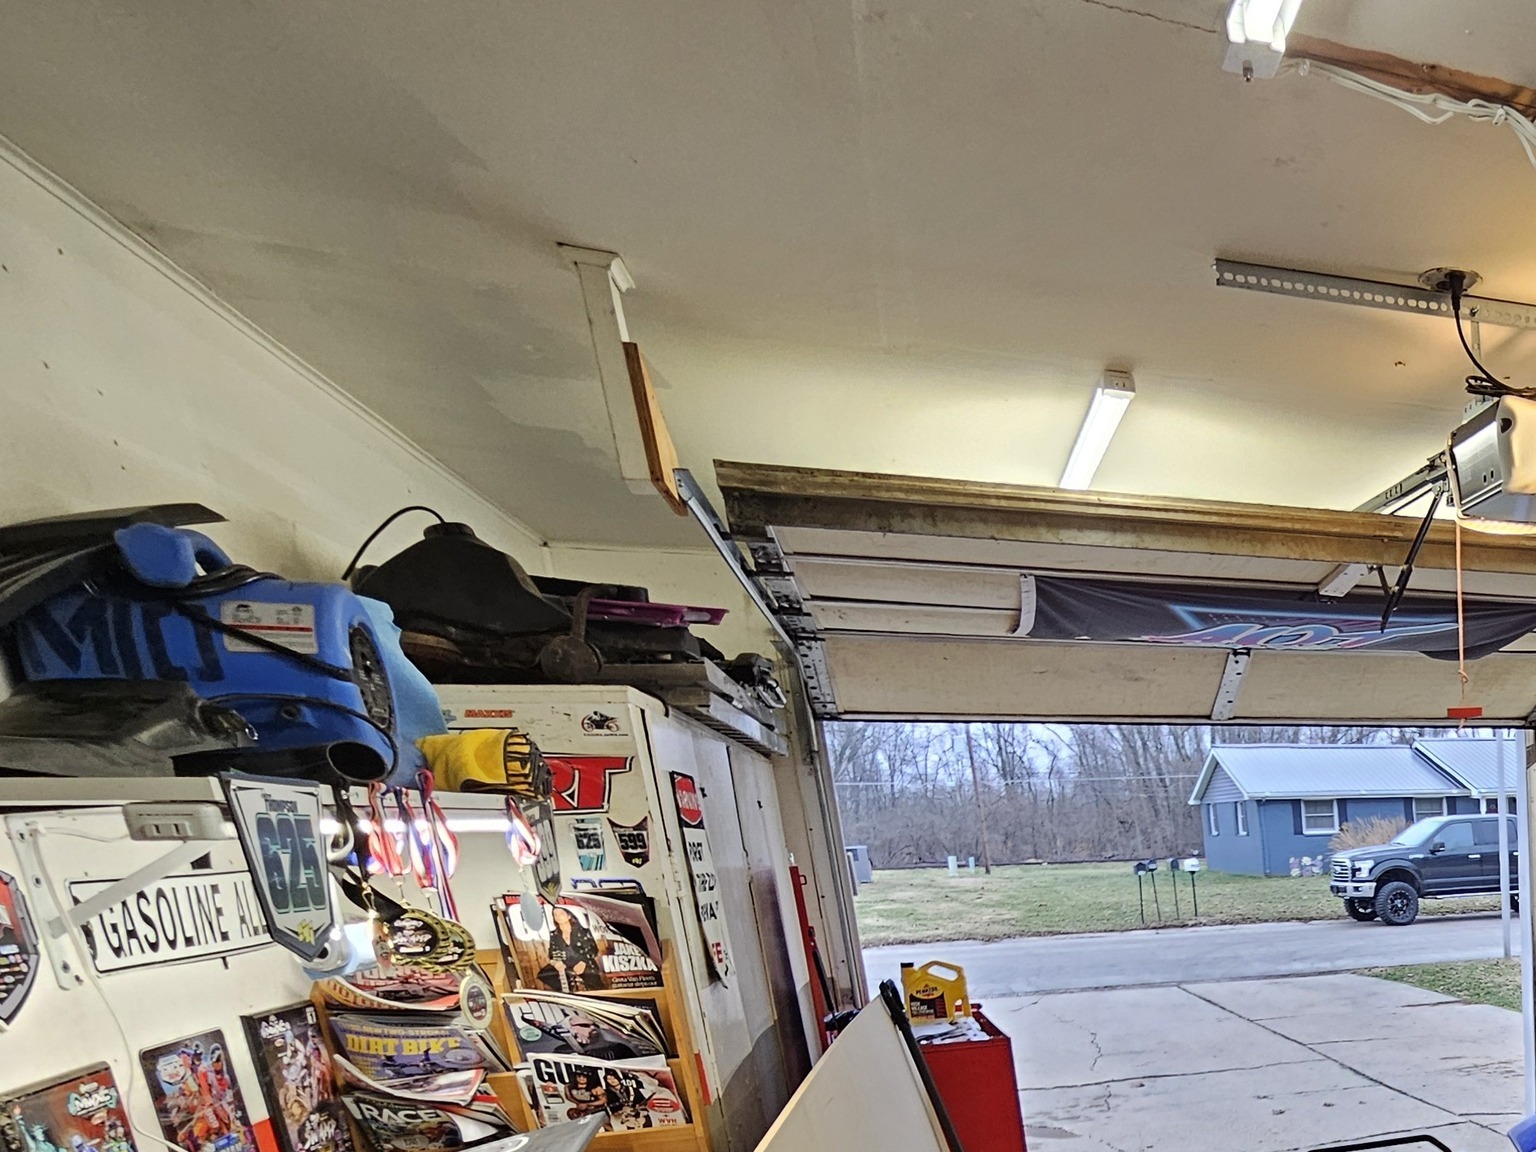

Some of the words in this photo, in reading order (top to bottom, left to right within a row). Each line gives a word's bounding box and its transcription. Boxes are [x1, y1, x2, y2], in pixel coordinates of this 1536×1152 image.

[618, 831, 648, 850] 599
[256, 811, 327, 915] 625
[99, 882, 230, 958] GASOLINE
[603, 955, 658, 972] KISZKA
[346, 1034, 400, 1056] DIRT
[402, 1037, 461, 1056] BIKE
